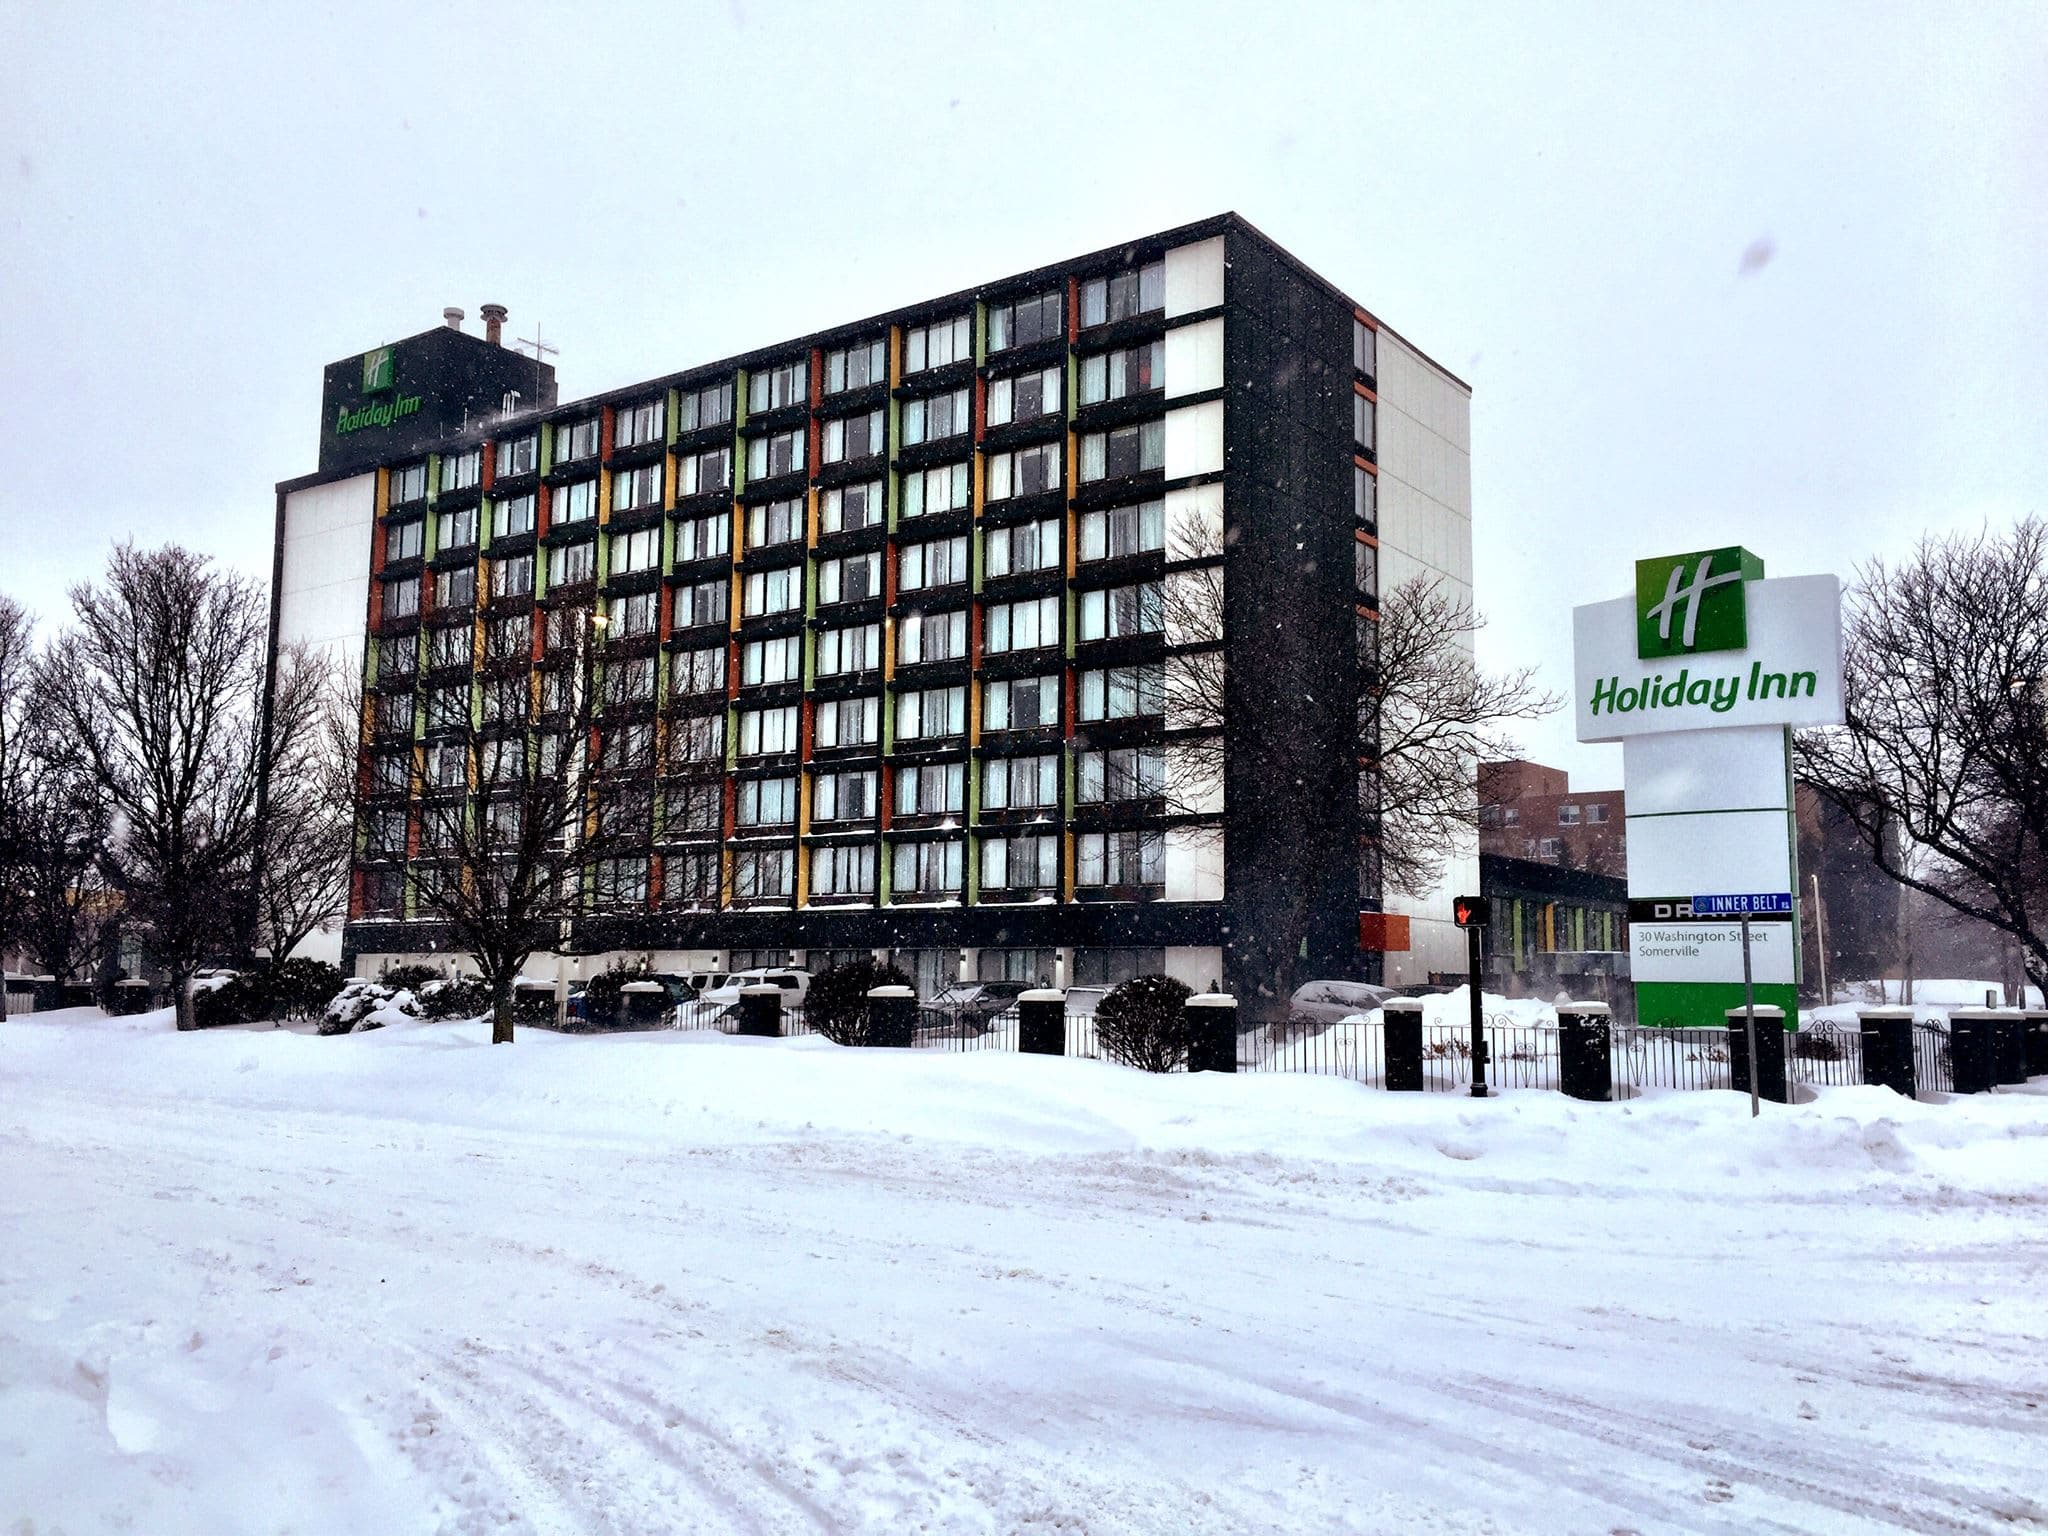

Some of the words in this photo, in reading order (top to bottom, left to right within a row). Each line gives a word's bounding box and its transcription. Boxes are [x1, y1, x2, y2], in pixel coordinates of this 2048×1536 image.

[336, 400, 394, 434] Holiday
[395, 393, 421, 418] Inn
[1590, 669, 1740, 716] Holiday
[1747, 661, 1817, 701] Inn
[1711, 896, 1748, 911] INNER
[1753, 895, 1778, 910] BELT
[1639, 931, 1652, 942] 30
[1654, 931, 1726, 944] Washington
[1729, 930, 1768, 942] Steet
[1639, 945, 1700, 957] Somerville
